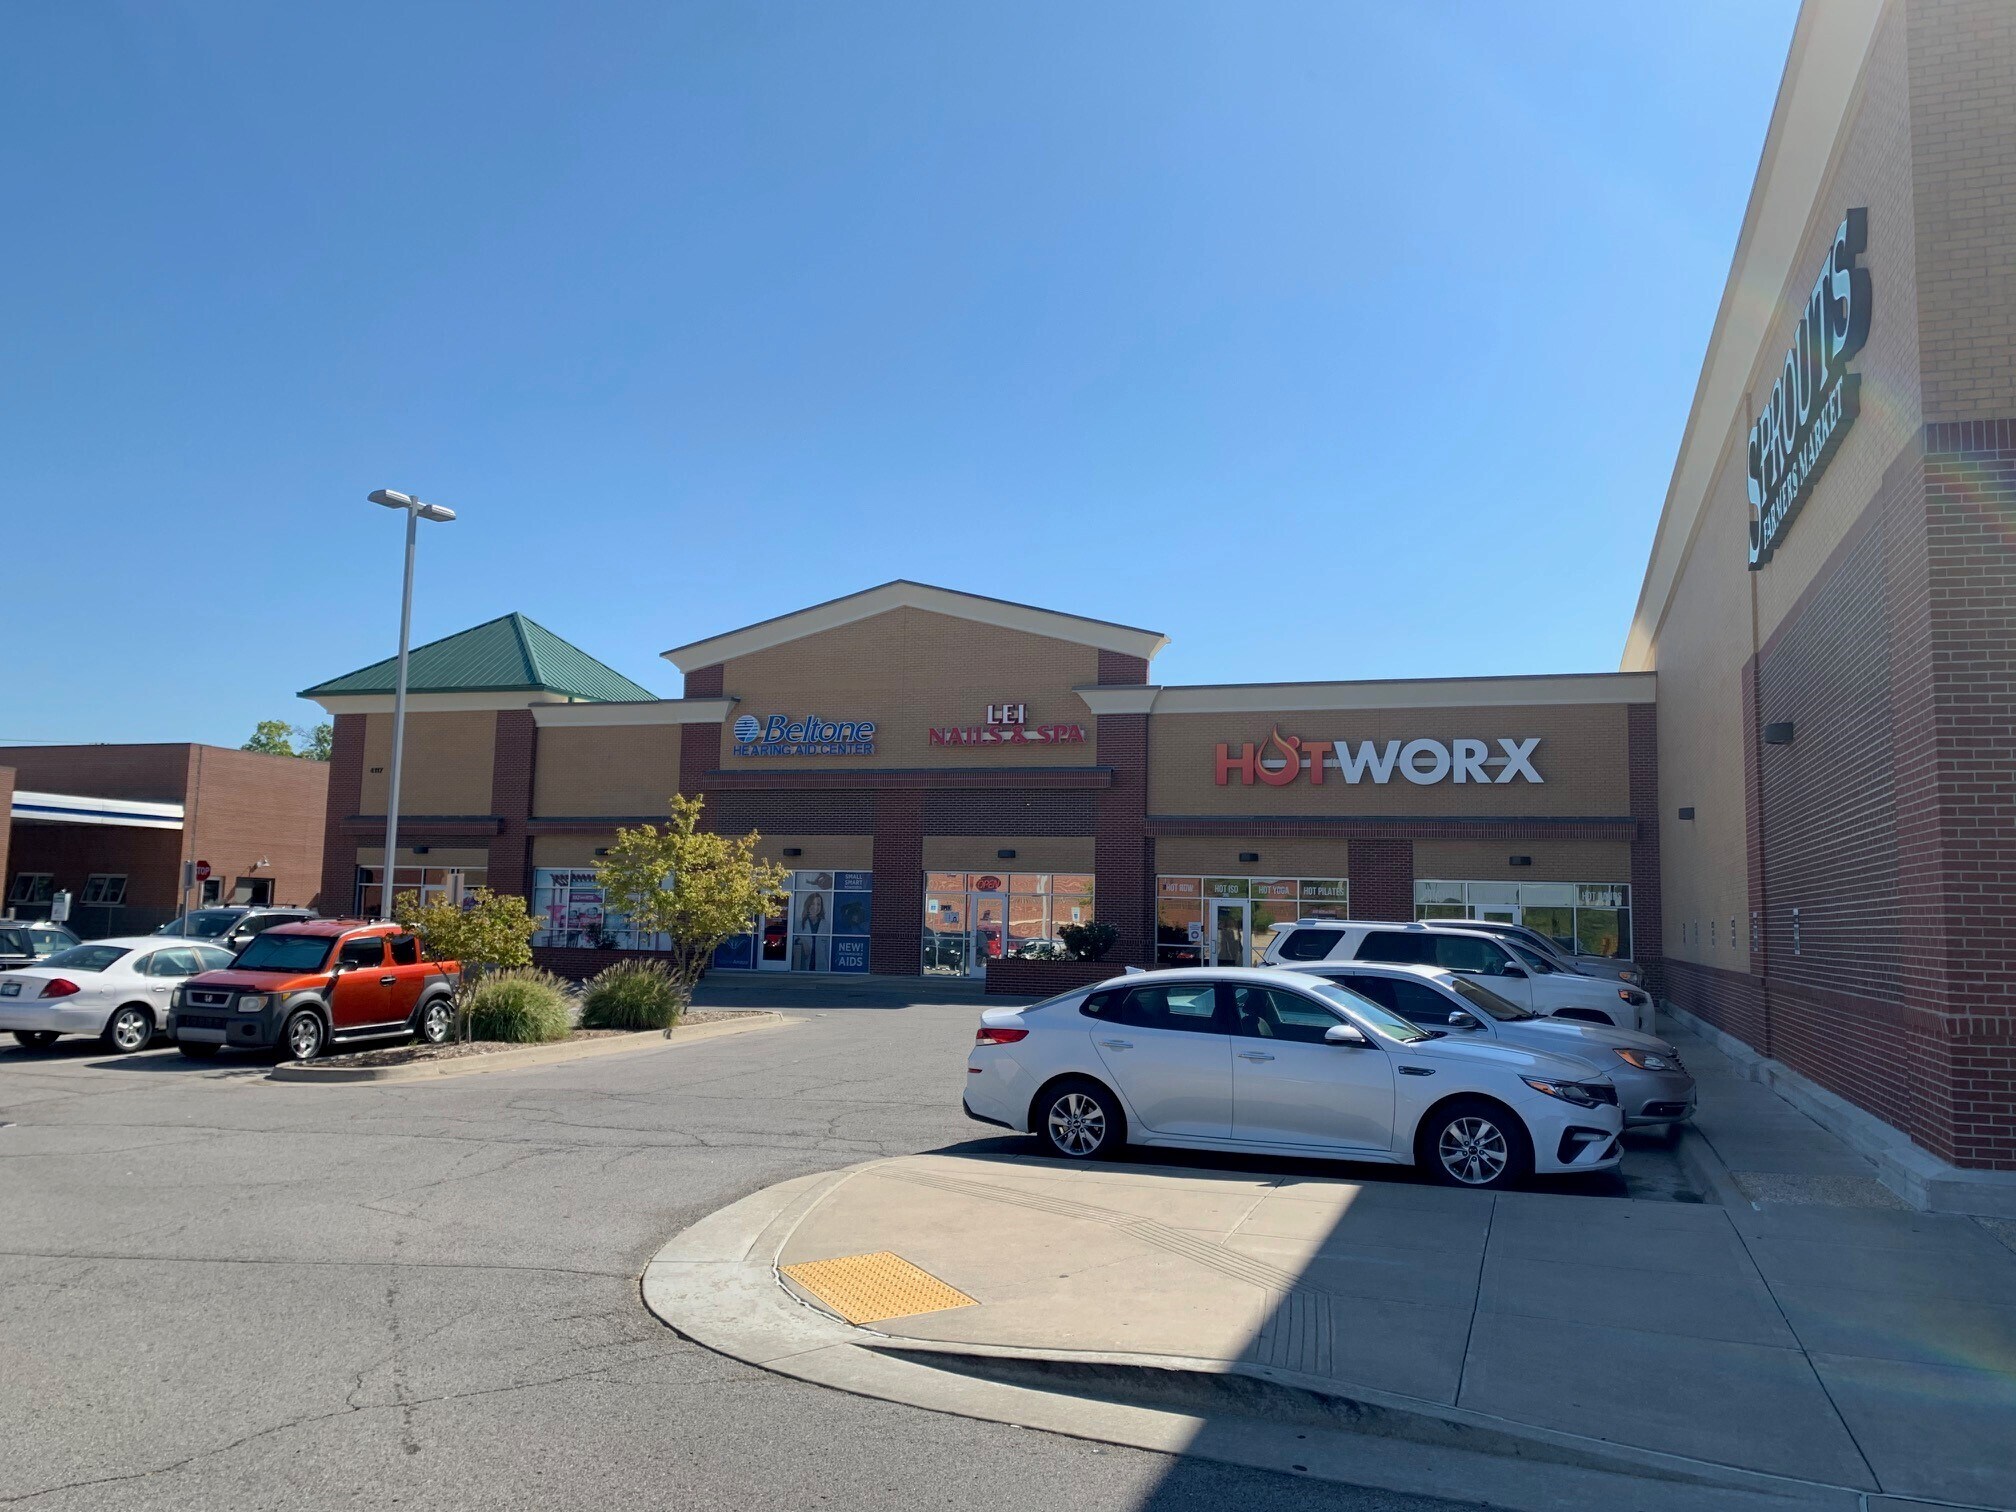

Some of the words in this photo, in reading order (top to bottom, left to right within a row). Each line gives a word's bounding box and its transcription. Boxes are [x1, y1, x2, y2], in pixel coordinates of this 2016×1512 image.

[1747, 218, 1852, 564] SPROUTS
[1763, 462, 1798, 550] FARMERS
[1799, 375, 1843, 486] MARKET
[986, 704, 1026, 725] LEI
[761, 714, 876, 744] Beltone
[928, 725, 1004, 746] NAILS
[1010, 724, 1030, 745] &
[1036, 724, 1087, 745] SPA
[733, 744, 791, 757] HEARING
[796, 744, 817, 756] AID
[820, 743, 875, 756] CENTER
[1215, 722, 1545, 786] HOTWORX
[977, 879, 1000, 889] OPEN
[1214, 884, 1227, 893] HOT
[1228, 884, 1239, 894] ISO
[1258, 885, 1272, 894] HOT
[1272, 886, 1290, 895] YOGA
[1303, 886, 1317, 896] HOT
[1318, 887, 1345, 896] PILATES
[838, 942, 864, 952] NEW!
[838, 956, 863, 967] AIDS
